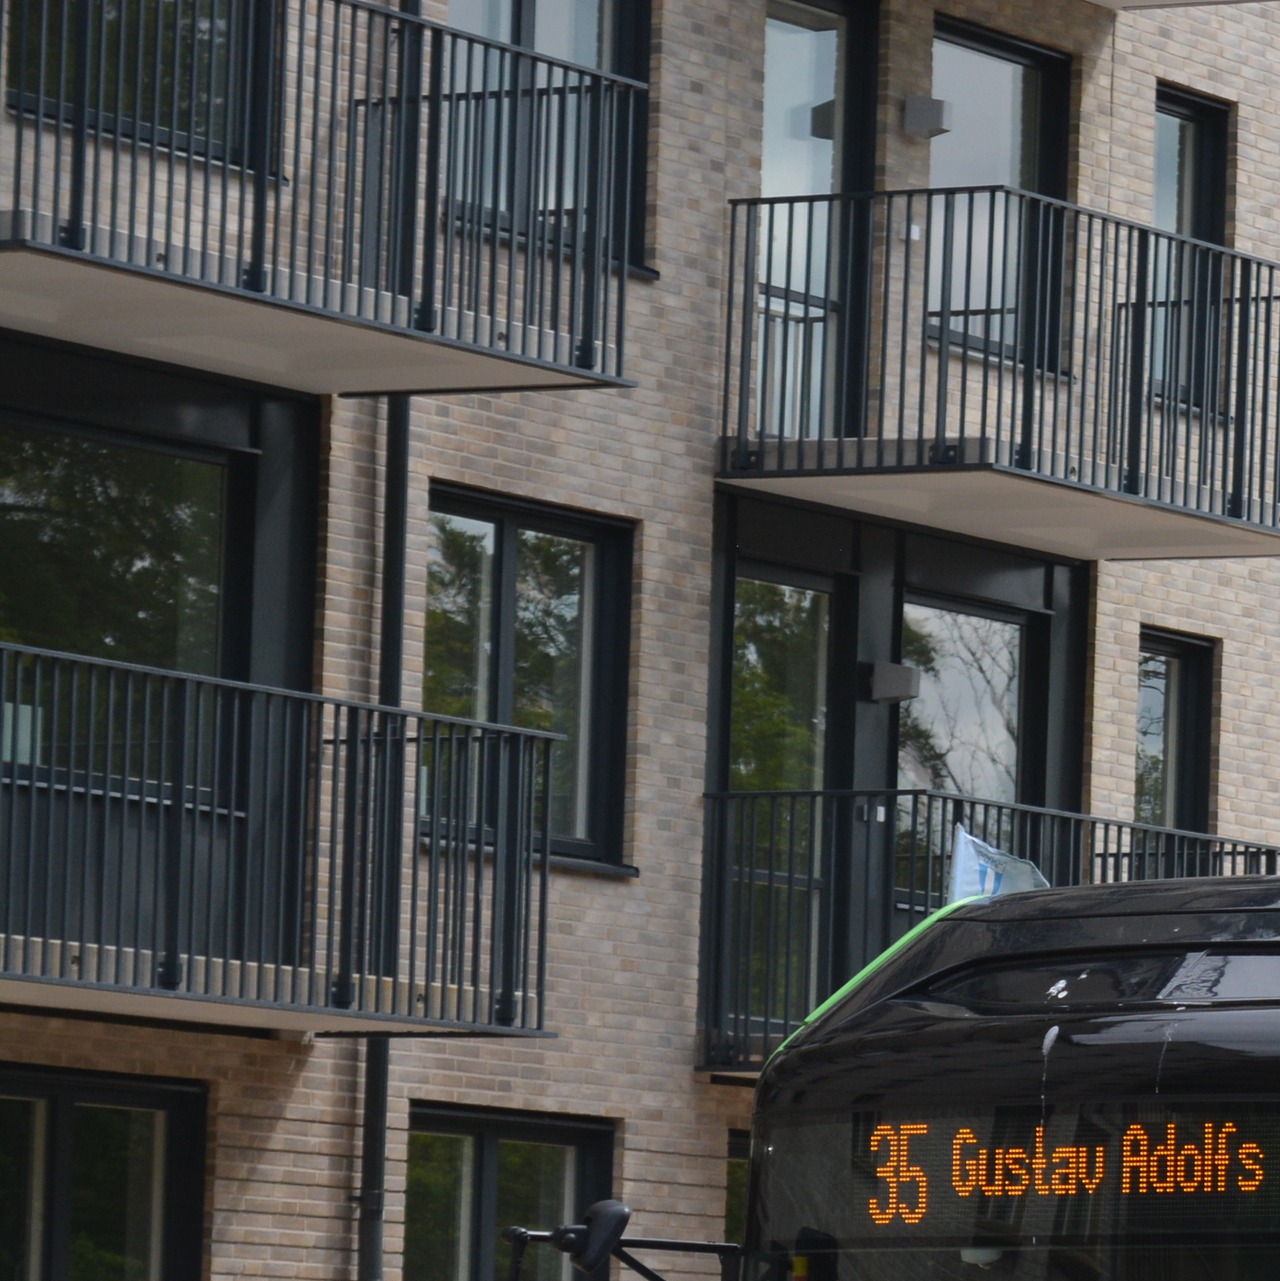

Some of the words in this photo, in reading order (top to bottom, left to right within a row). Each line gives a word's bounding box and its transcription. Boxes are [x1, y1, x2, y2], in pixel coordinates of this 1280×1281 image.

[868, 1123, 929, 1225] 35
[951, 1127, 1105, 1196] Gustav
[1121, 1122, 1265, 1193] Adolfs
